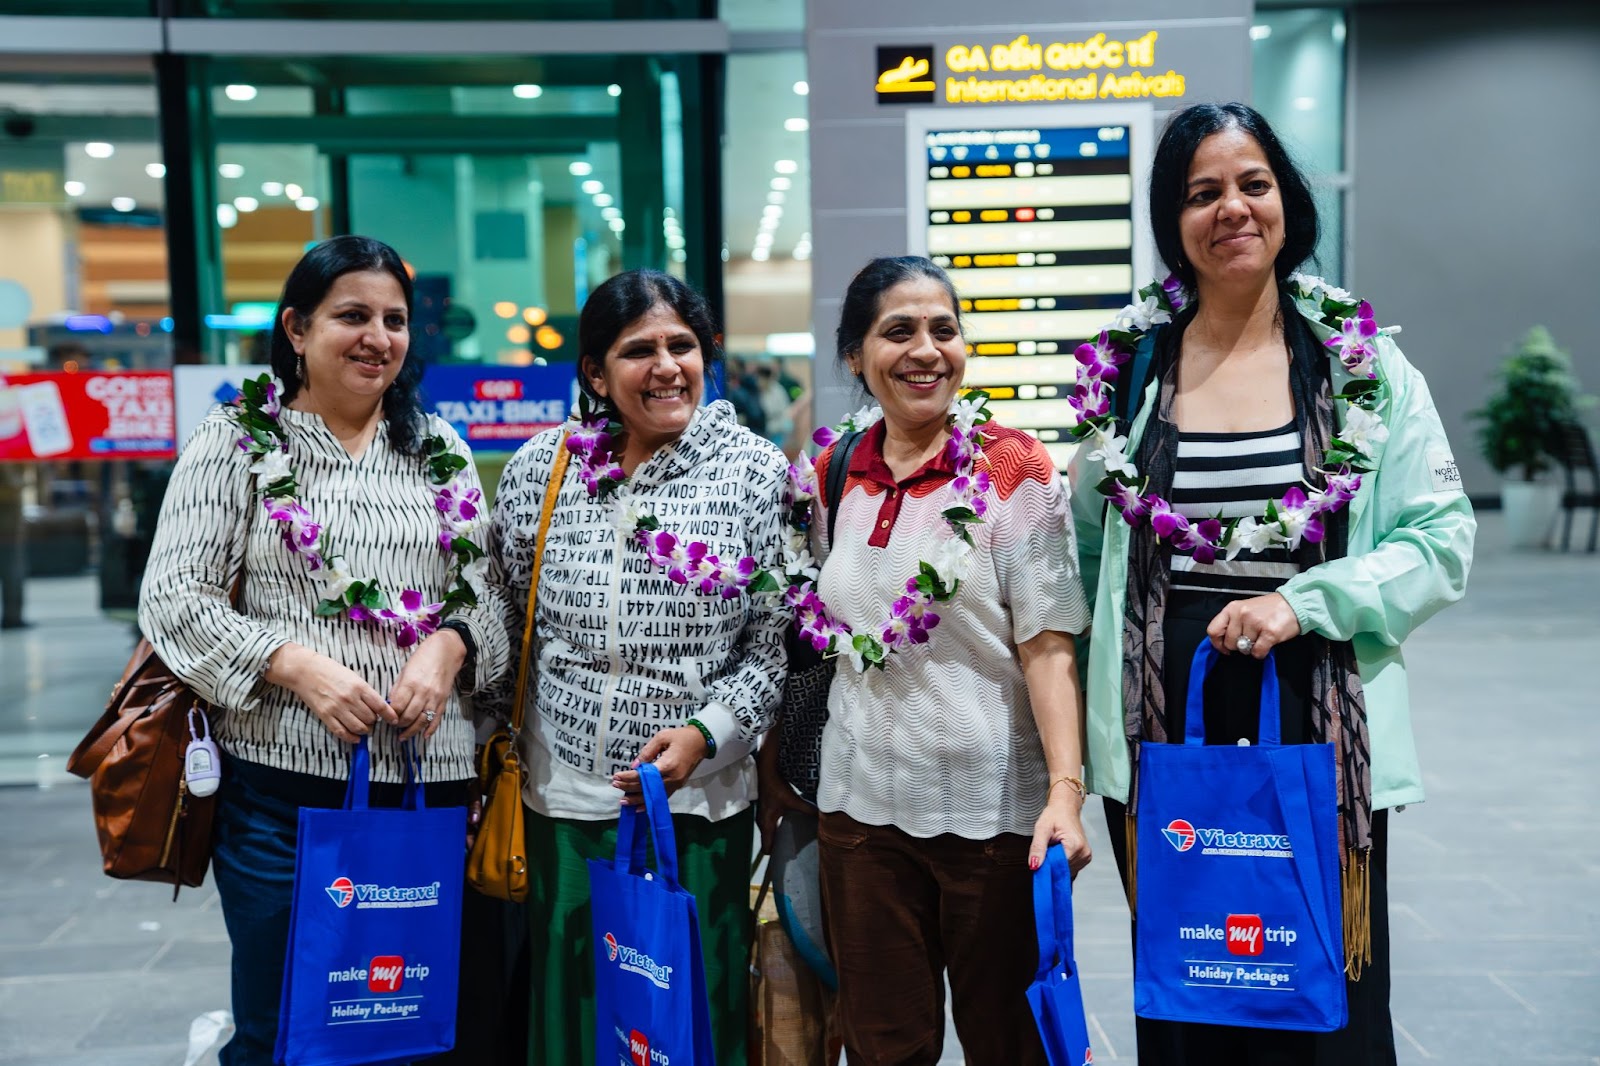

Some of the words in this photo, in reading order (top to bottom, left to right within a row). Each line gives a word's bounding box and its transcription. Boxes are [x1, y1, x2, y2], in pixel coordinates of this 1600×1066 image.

[945, 45, 989, 72] GA
[945, 73, 1097, 103] International
[1098, 70, 1185, 98] Arrivals
[1435, 467, 1457, 476] NORT
[1444, 474, 1461, 483] FAC
[563, 692, 602, 717] MAKE
[611, 697, 647, 717] LOVE
[1197, 829, 1292, 849] Vietrave
[1179, 924, 1225, 940] make
[1228, 925, 1260, 953] my
[1264, 926, 1297, 946] trip
[328, 966, 368, 983] make
[371, 965, 402, 990] my
[404, 964, 430, 981] trip
[1188, 965, 1233, 984] Holiday
[1236, 968, 1290, 987] Packages
[331, 1005, 371, 1019] Holiday
[373, 1003, 419, 1017] Packages
[650, 1048, 669, 1066] trip
